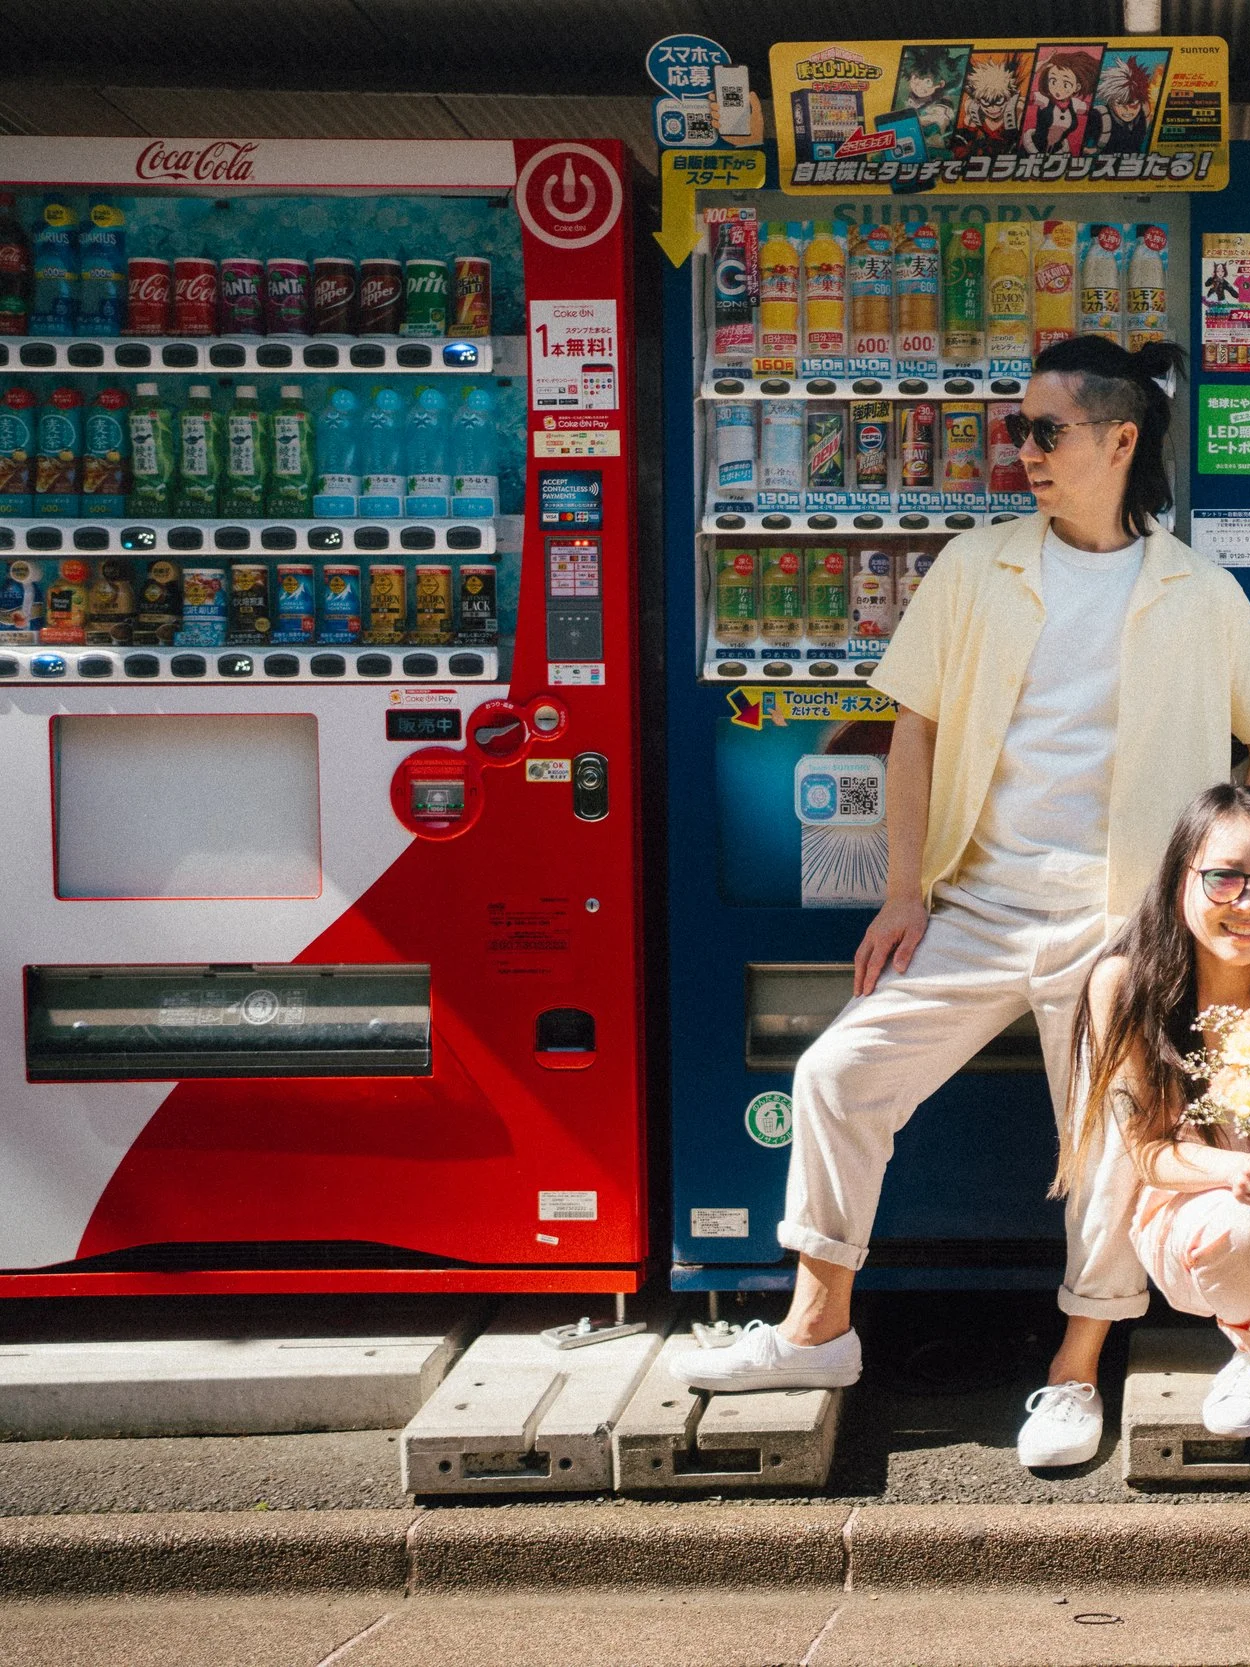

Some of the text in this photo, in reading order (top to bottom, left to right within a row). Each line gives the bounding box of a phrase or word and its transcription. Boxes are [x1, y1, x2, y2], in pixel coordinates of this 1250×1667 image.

[658, 46, 722, 64] スマホで
[668, 66, 711, 87] 応募
[812, 81, 870, 92] キャンペーン
[136, 139, 258, 182] Coca-Cola
[674, 156, 756, 171] 自販機下から
[686, 172, 738, 185] スタート
[553, 224, 572, 232] Coke
[865, 257, 892, 279] 麦茶
[911, 255, 938, 278] 麦茶
[992, 293, 1025, 302] LEMON
[1086, 290, 1114, 301] レモン
[1130, 290, 1160, 301] レモン
[553, 308, 594, 318] Coke ON
[992, 303, 1010, 313] TEA
[536, 323, 613, 358] 1本無料!
[755, 359, 794, 371] 160円
[803, 358, 843, 370] 160円
[849, 359, 890, 371] 140円
[900, 361, 937, 372] 140円
[992, 359, 1031, 371] 170円
[852, 402, 890, 421] 強刺激
[558, 420, 609, 430] Coke ON Pay
[951, 425, 976, 438] C.C.
[542, 485, 588, 493] CONTACTLESS
[542, 492, 576, 500] PAYMENTS
[759, 493, 799, 505] 130円
[807, 493, 847, 505] 140円
[850, 493, 890, 505] 140円
[900, 493, 940, 505] 140円
[945, 493, 986, 504] 140円
[989, 493, 1032, 504] 140円
[405, 695, 424, 703] Coke
[438, 695, 454, 704] Pay
[783, 690, 839, 705] Touch!
[399, 717, 453, 733] 販売中
[552, 762, 564, 770] OK
